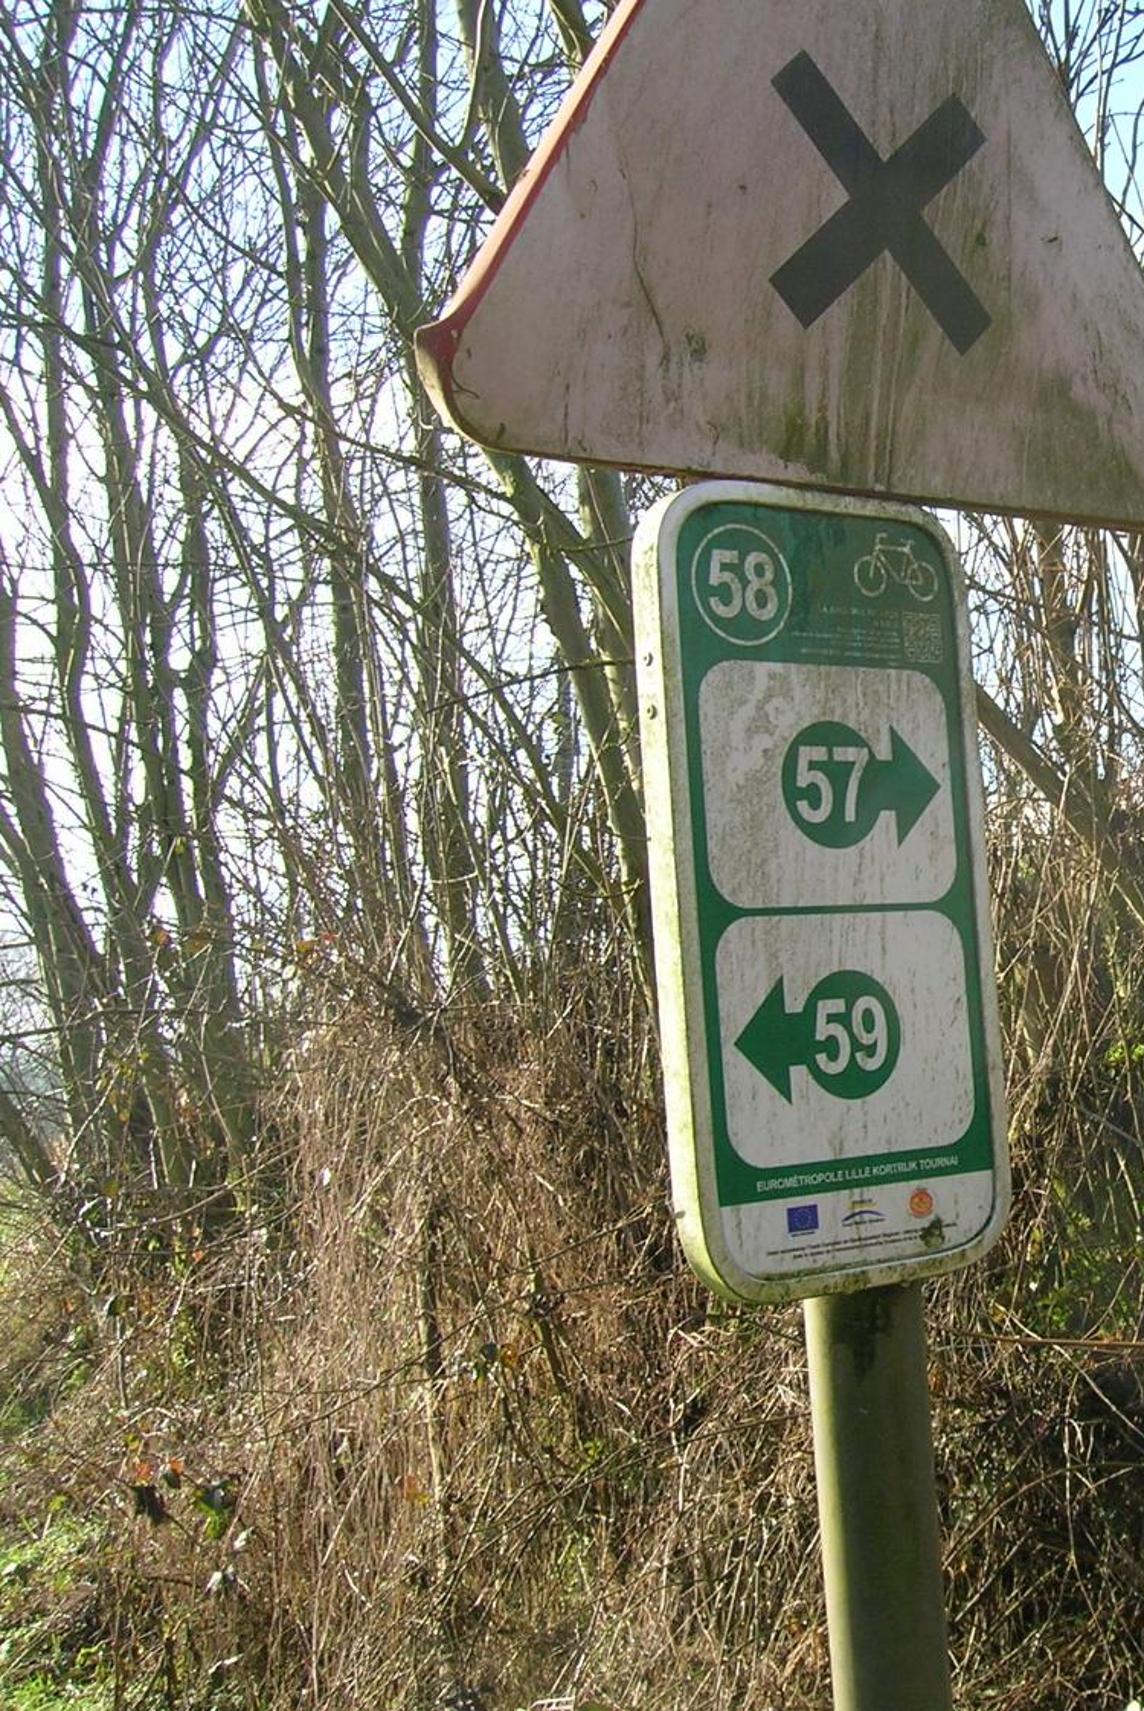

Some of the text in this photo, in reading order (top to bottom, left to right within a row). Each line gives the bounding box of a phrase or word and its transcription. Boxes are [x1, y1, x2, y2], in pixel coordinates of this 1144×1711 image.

[708, 549, 779, 622] 58
[795, 745, 870, 824] 57
[814, 996, 888, 1075] 59
[756, 1155, 959, 1192] EUROMÉTROPOLE LILLE KORTRIJK TOURNAI
